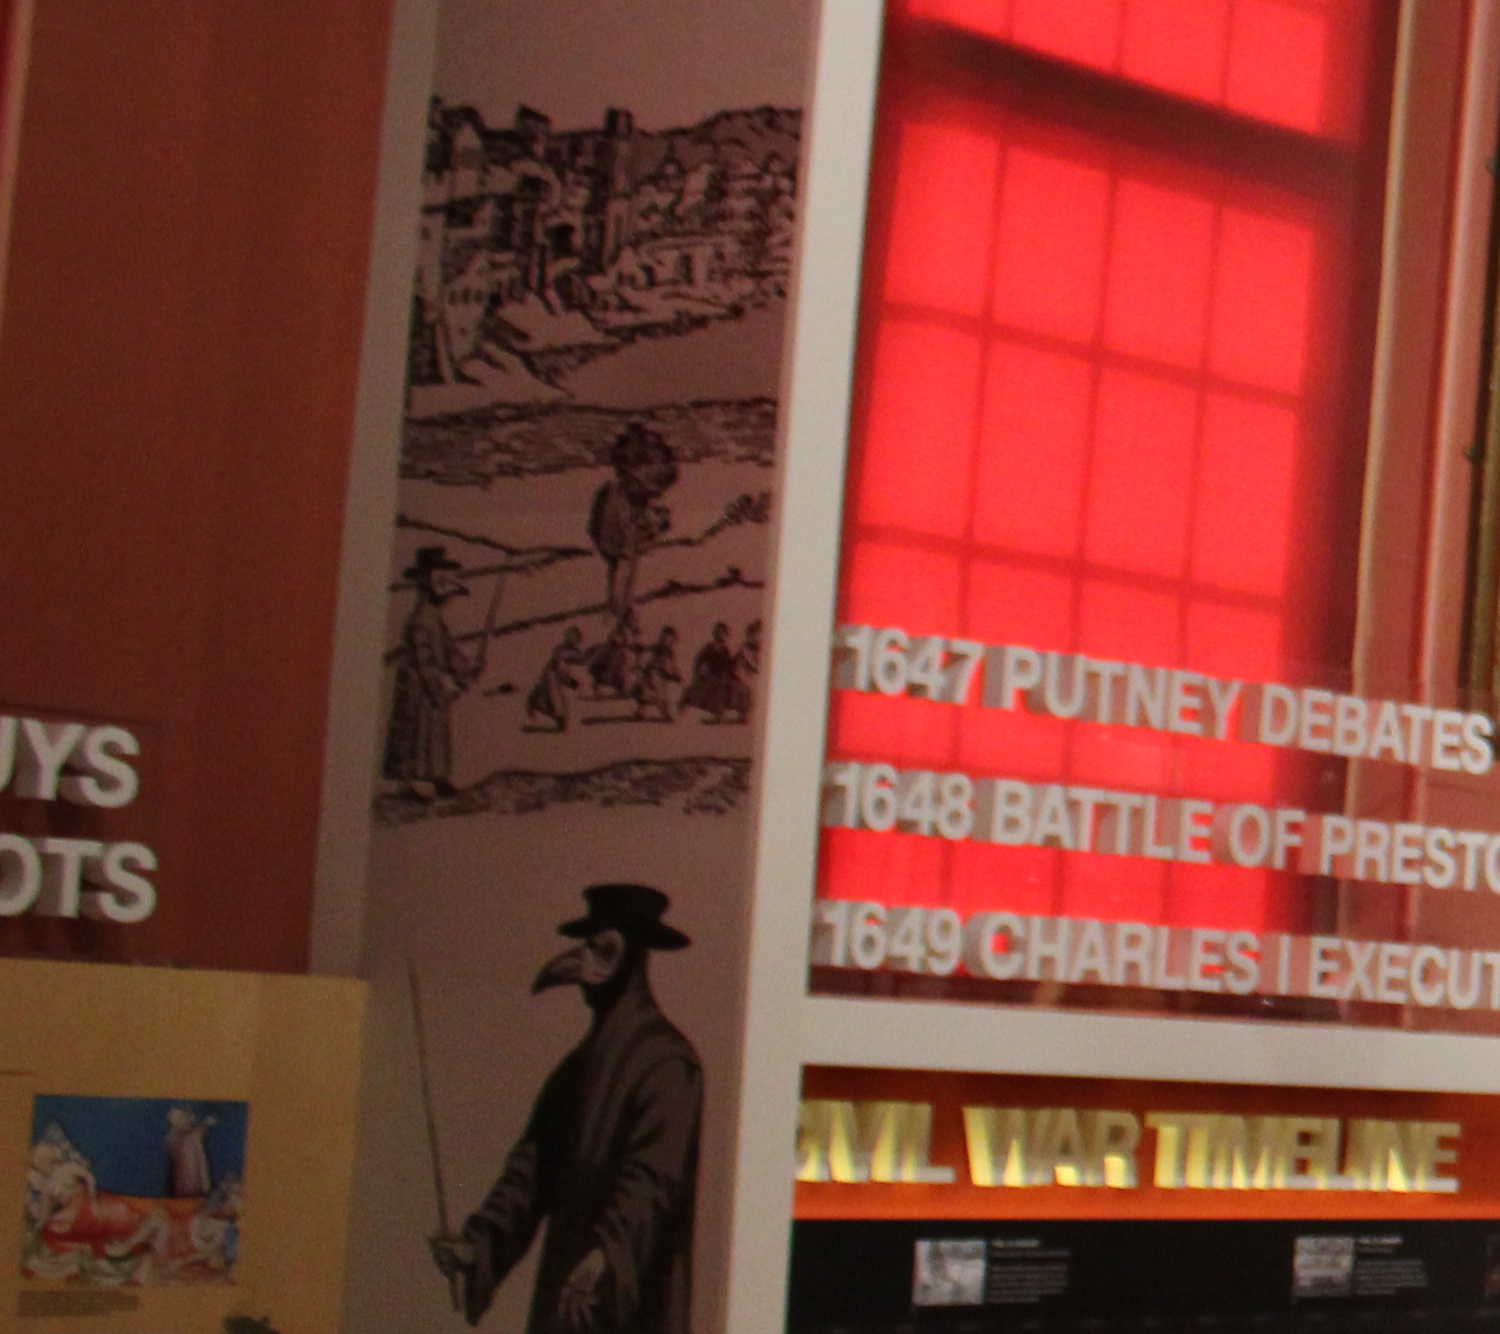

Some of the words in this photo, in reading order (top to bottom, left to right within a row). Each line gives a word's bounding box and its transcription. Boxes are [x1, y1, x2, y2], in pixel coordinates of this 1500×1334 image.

[843, 629, 985, 704] 1647
[1001, 646, 1241, 739] PUTNEY
[1260, 683, 1494, 774] DEBATES
[835, 762, 972, 840] 1648
[991, 779, 1210, 862] BATTLE
[1229, 804, 1306, 868] OF
[824, 902, 961, 976] 1649
[979, 913, 1260, 995] CHARLES
[1276, 935, 1290, 995] I
[963, 1106, 1141, 1187] WAR
[1145, 1112, 1461, 1193] TIMELINE
